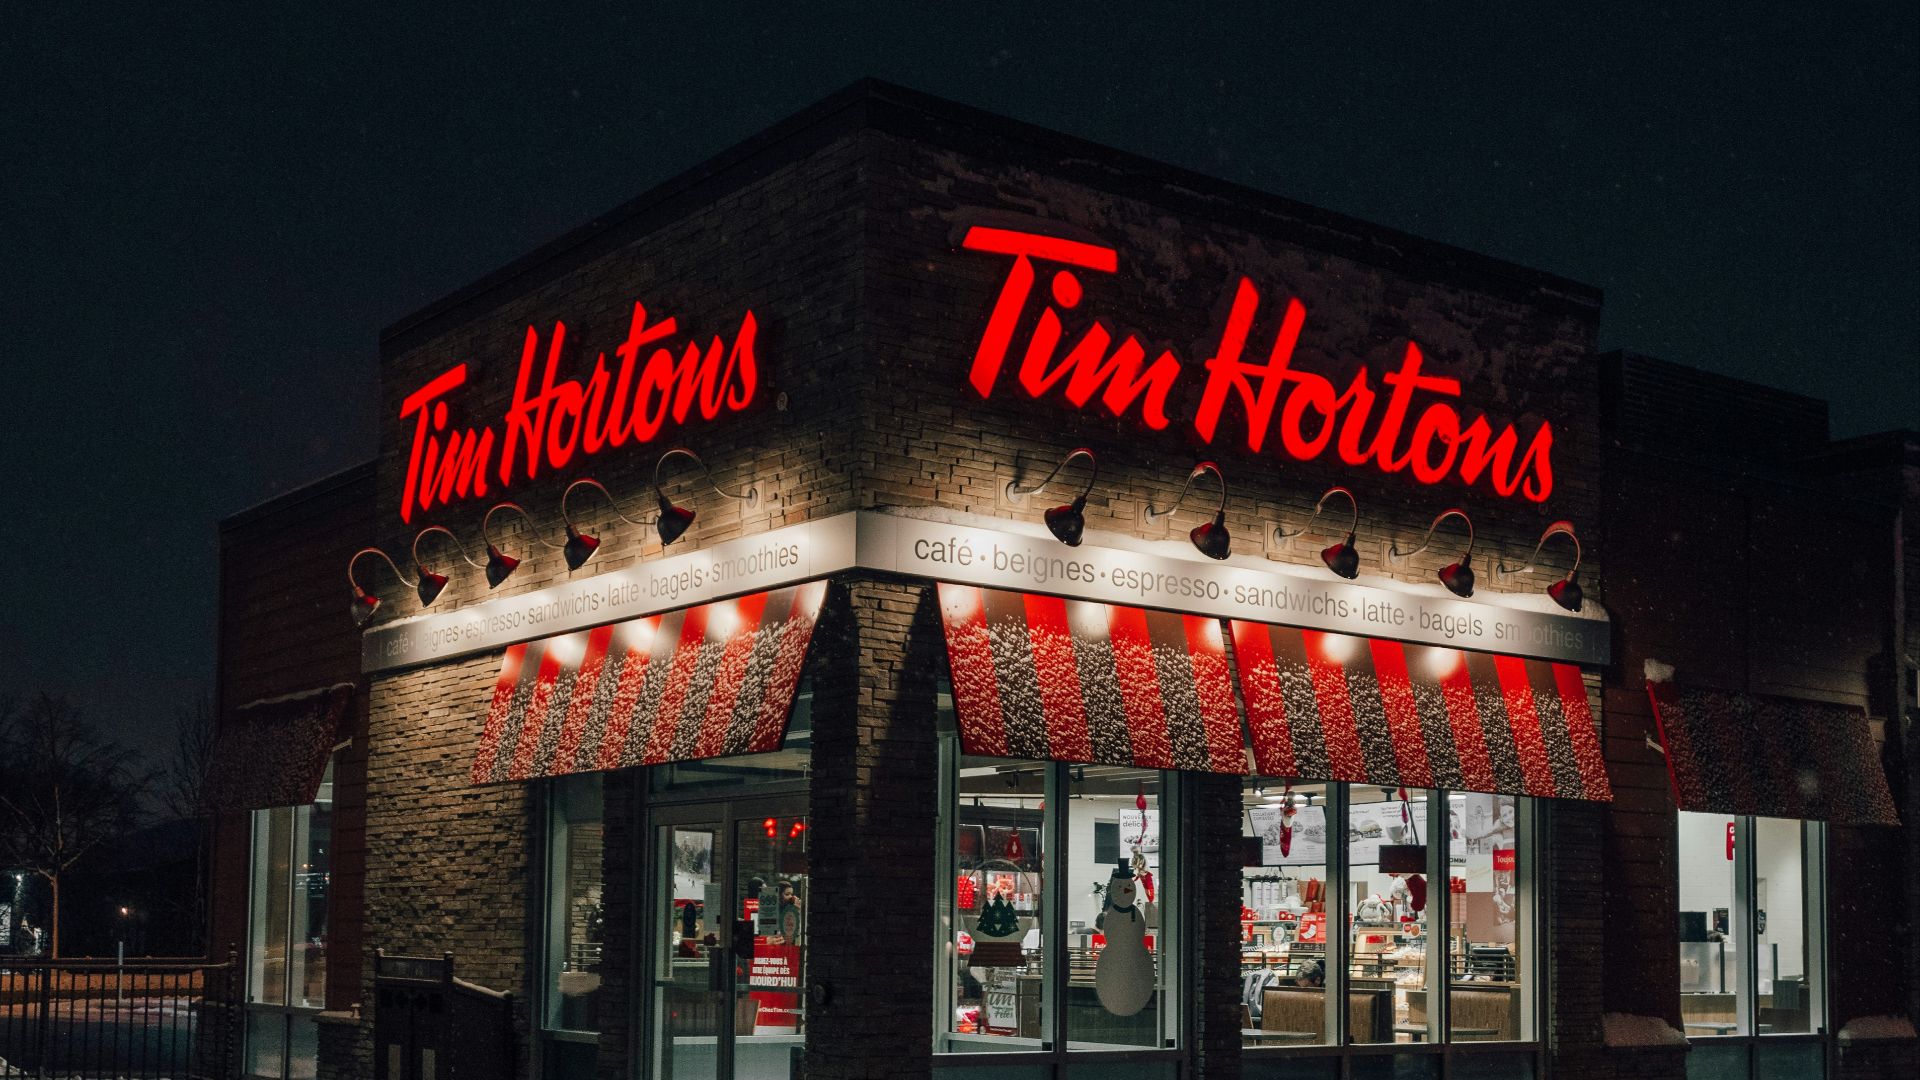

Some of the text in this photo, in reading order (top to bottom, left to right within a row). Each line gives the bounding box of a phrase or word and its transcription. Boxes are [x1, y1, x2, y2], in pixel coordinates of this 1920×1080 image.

[400, 300, 758, 525] Tim Hortons
[962, 226, 1554, 503] Tim Hortons
[386, 542, 799, 657] café eignes espresso sandwichs latte bagels smoothies
[914, 537, 973, 566] café
[993, 544, 1096, 584] beignes
[1111, 567, 1220, 601] espresso
[1234, 584, 1349, 618] sandwichs
[1362, 597, 1405, 626] latte
[1419, 605, 1484, 638] bagels
